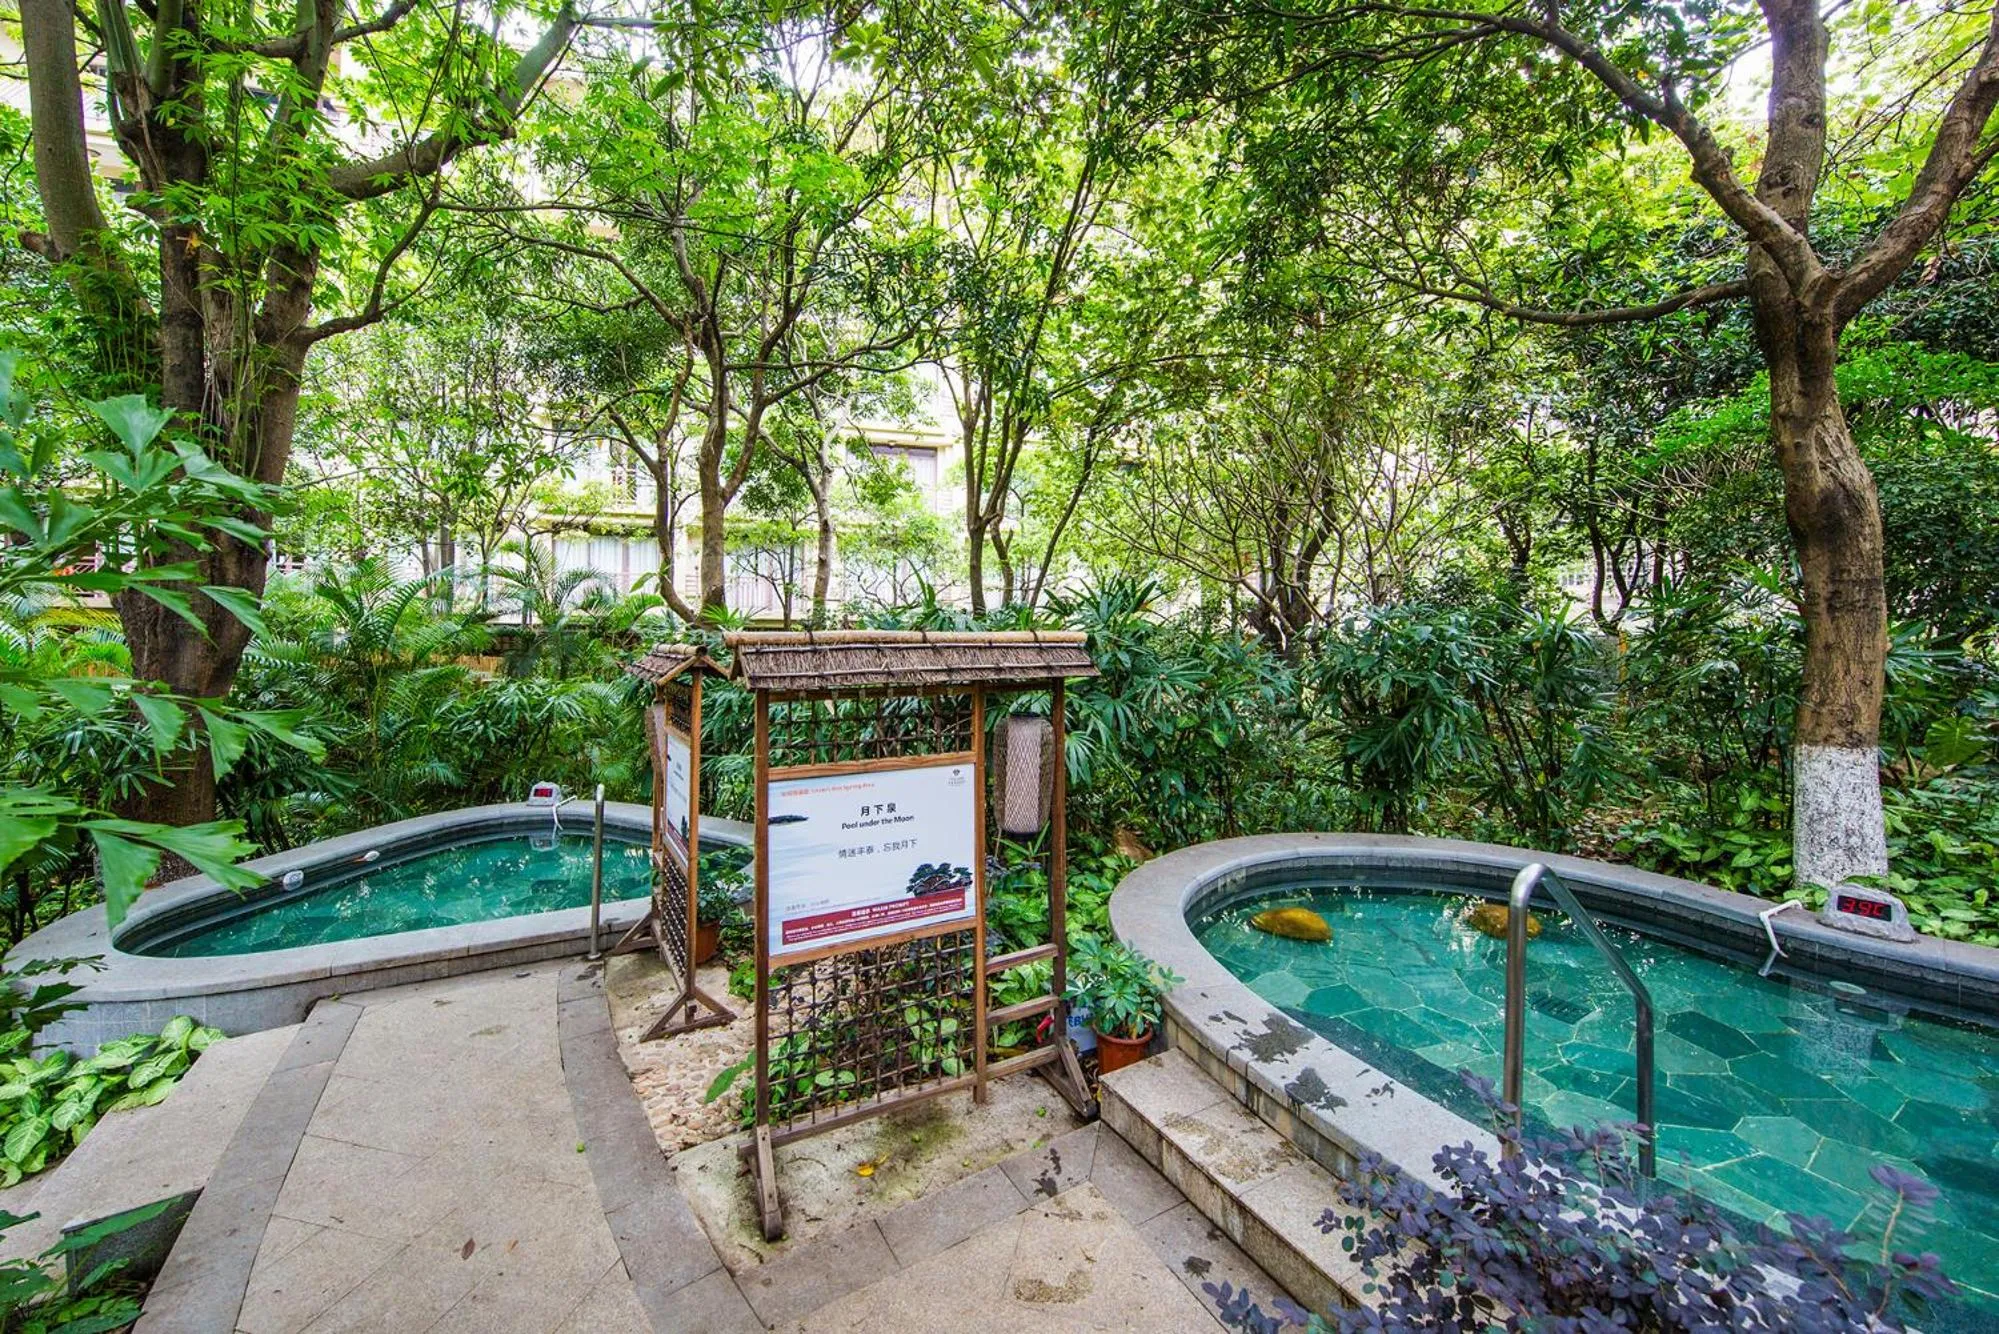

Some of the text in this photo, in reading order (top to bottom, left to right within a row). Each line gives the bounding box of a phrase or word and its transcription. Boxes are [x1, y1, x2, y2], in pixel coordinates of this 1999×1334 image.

[860, 803, 896, 817] 月下泉
[842, 815, 914, 830] Pool under the Moon
